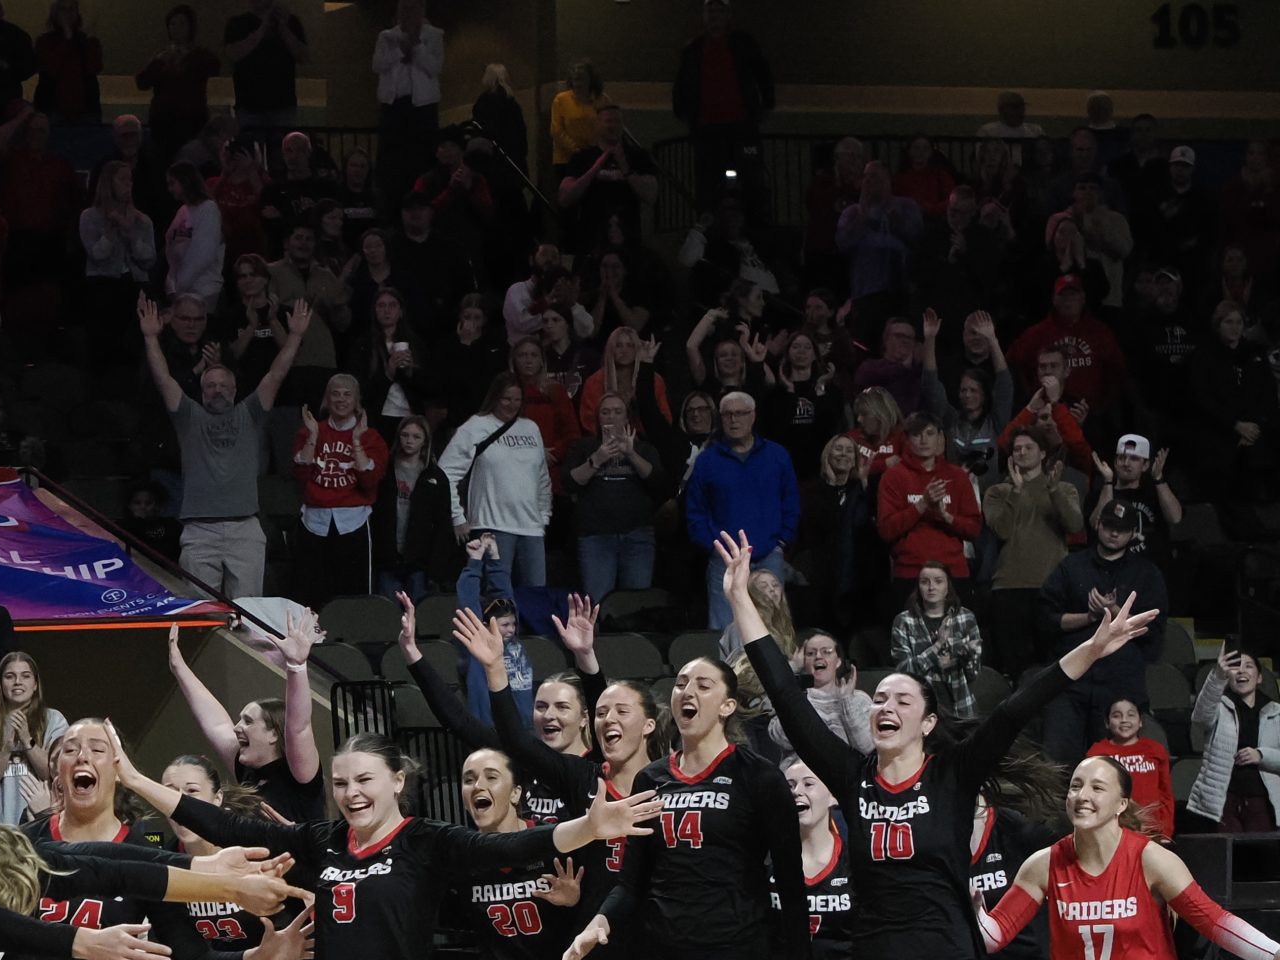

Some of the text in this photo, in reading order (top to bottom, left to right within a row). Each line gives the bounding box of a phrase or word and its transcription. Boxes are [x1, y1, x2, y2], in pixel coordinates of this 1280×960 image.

[1151, 4, 1239, 48] 105
[1069, 356, 1093, 368] ERS
[321, 441, 352, 456] AIDE
[315, 473, 357, 488] ATION
[156, 595, 177, 608] Are
[651, 791, 730, 810] AIDERS
[859, 796, 930, 821] RAIDERS
[660, 811, 704, 849] 14
[870, 821, 915, 861] 10
[472, 878, 550, 902] RAIDERS
[40, 897, 103, 929] 24
[187, 901, 245, 917] AIDER
[332, 882, 357, 923] 9
[1056, 896, 1138, 920] RAIDERS
[486, 901, 543, 937] 20
